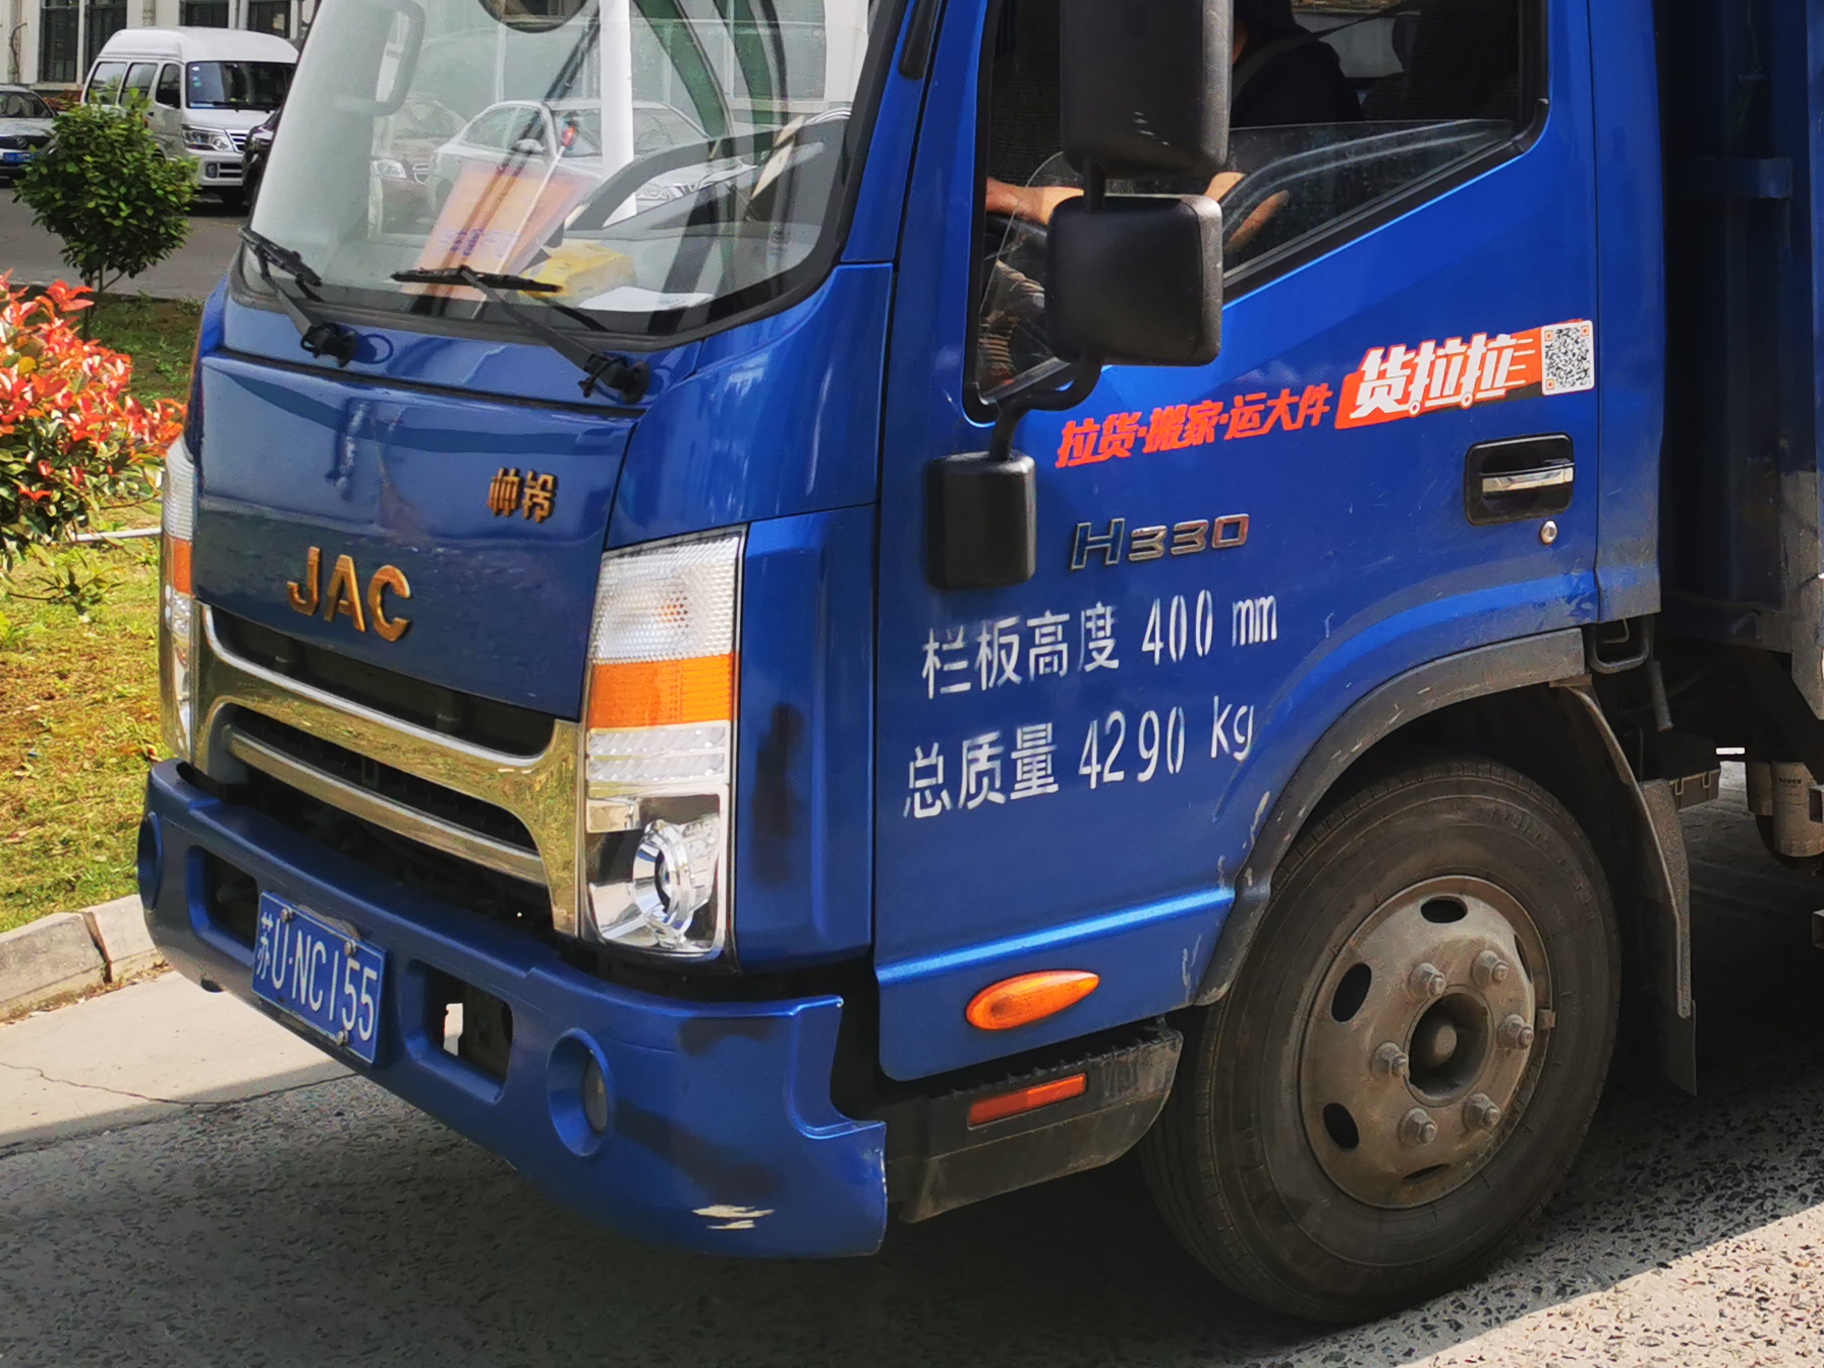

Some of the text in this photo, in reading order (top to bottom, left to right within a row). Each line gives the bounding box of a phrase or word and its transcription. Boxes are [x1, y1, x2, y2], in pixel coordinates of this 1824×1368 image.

[1349, 332, 1525, 417] 货拉拉
[1069, 513, 1250, 571] H330
[286, 545, 411, 643] JAC
[921, 589, 1279, 700] 栏板高度 400 mm
[902, 694, 1255, 820] 总质量 4290 kg
